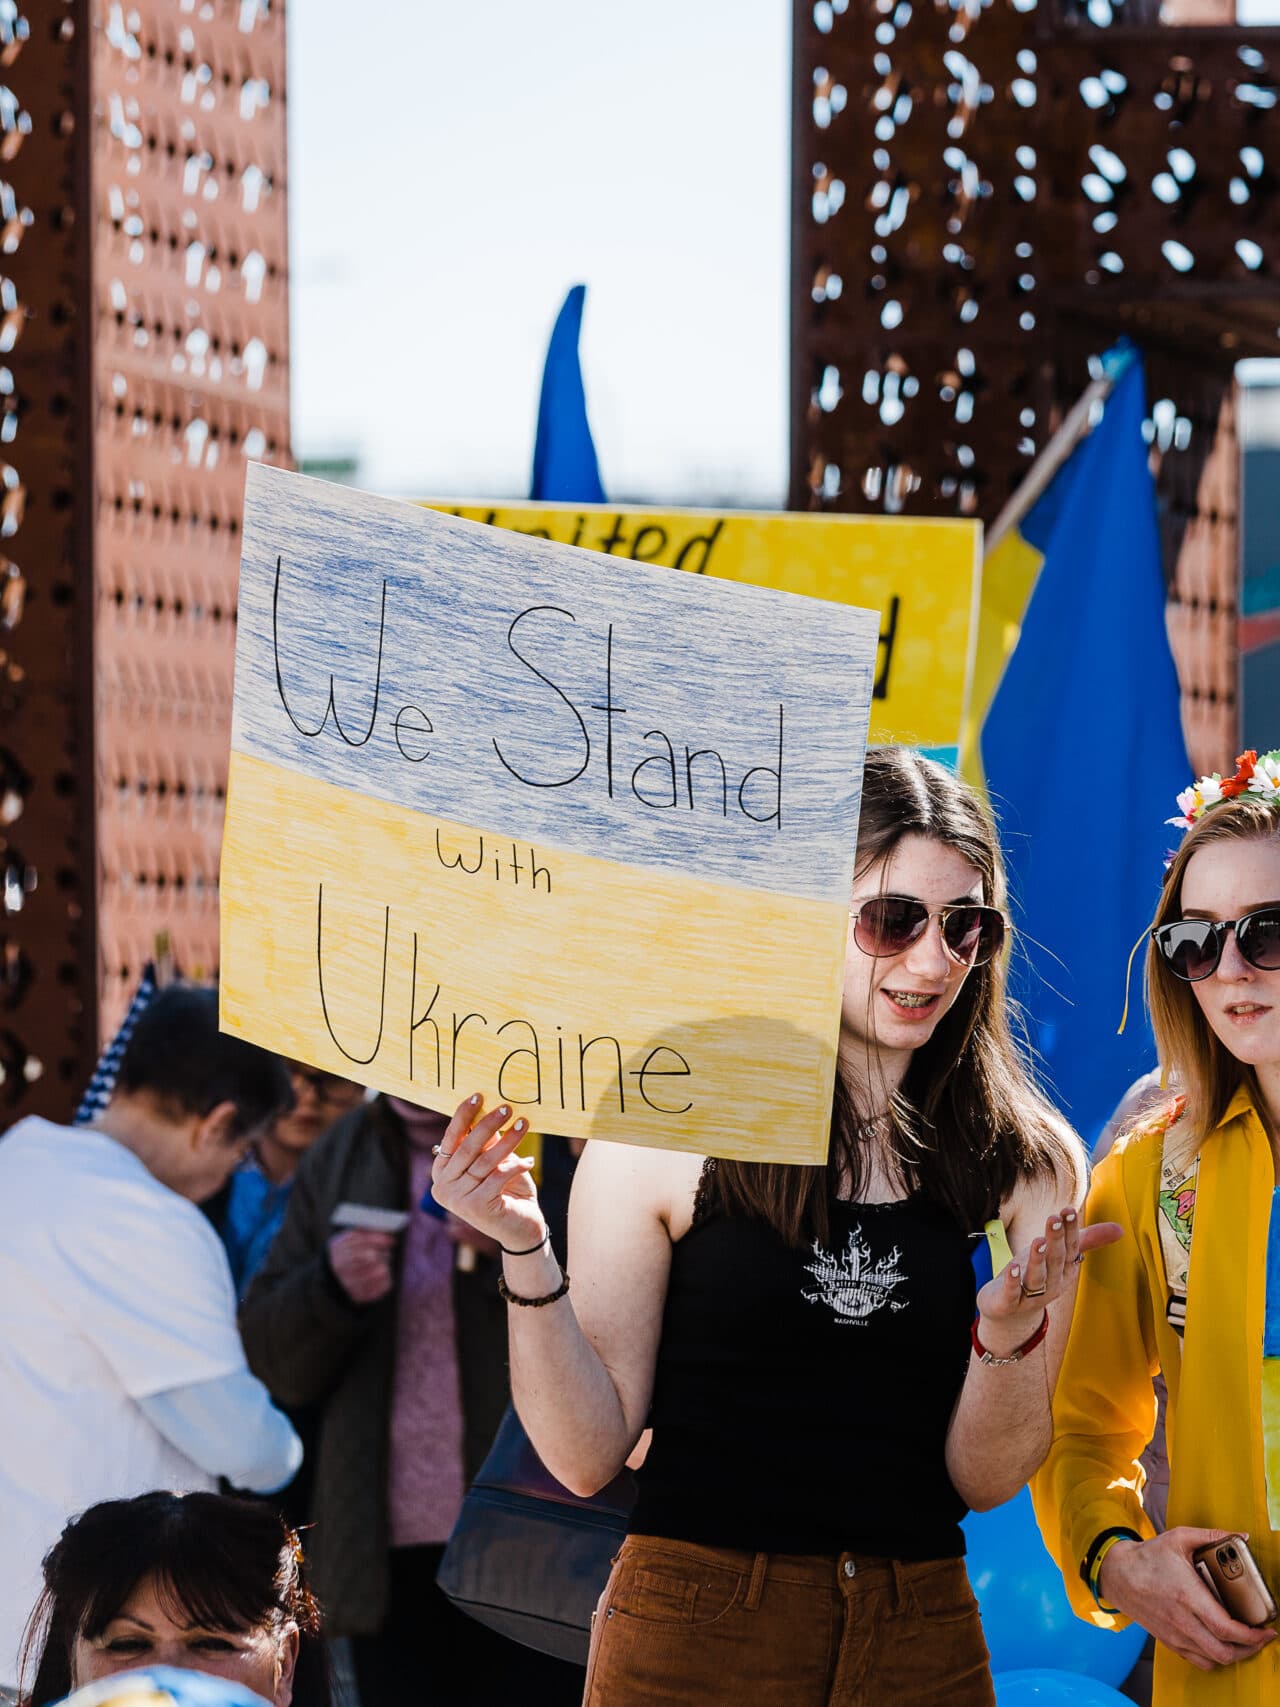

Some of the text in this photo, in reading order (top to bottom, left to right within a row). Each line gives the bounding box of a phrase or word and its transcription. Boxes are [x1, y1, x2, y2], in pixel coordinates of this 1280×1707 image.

[272, 555, 434, 763] We
[492, 606, 784, 830] Stand
[316, 883, 694, 1114] Ukraine
